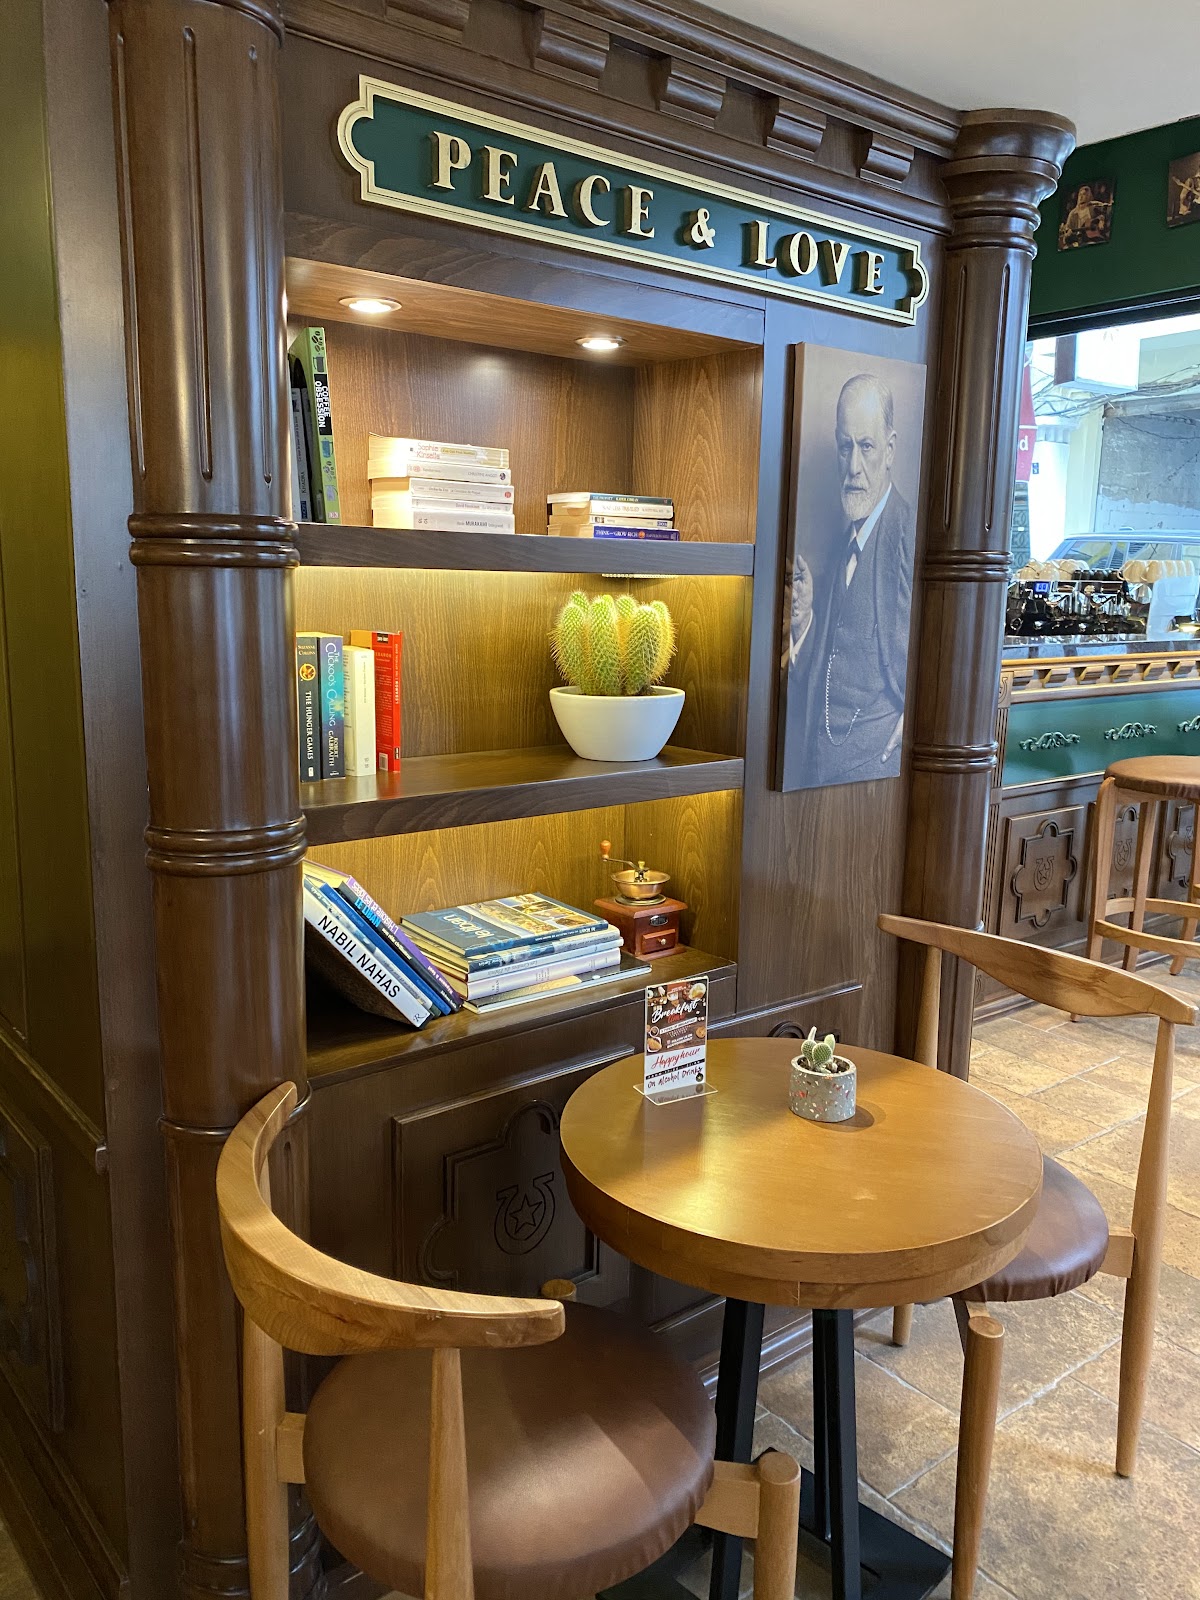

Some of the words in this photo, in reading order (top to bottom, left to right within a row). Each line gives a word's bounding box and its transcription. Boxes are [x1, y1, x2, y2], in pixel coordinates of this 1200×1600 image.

[431, 130, 656, 239] PEACE
[689, 206, 717, 249] &
[749, 219, 887, 295] LOVE
[314, 380, 326, 428] OBSESSION
[321, 384, 332, 418] COFFEE
[305, 706, 313, 736] HUNGER
[326, 688, 338, 727] CALLING
[306, 737, 314, 760] GAMES
[354, 896, 364, 910] LE
[361, 904, 382, 928] LIBAN
[443, 914, 482, 933] liban
[475, 929, 495, 939] le
[317, 915, 357, 958] NABIL
[356, 953, 401, 999] NAHAS
[651, 998, 701, 1024] Breakfast
[651, 1054, 680, 1070] Happy
[680, 1047, 701, 1060] hour
